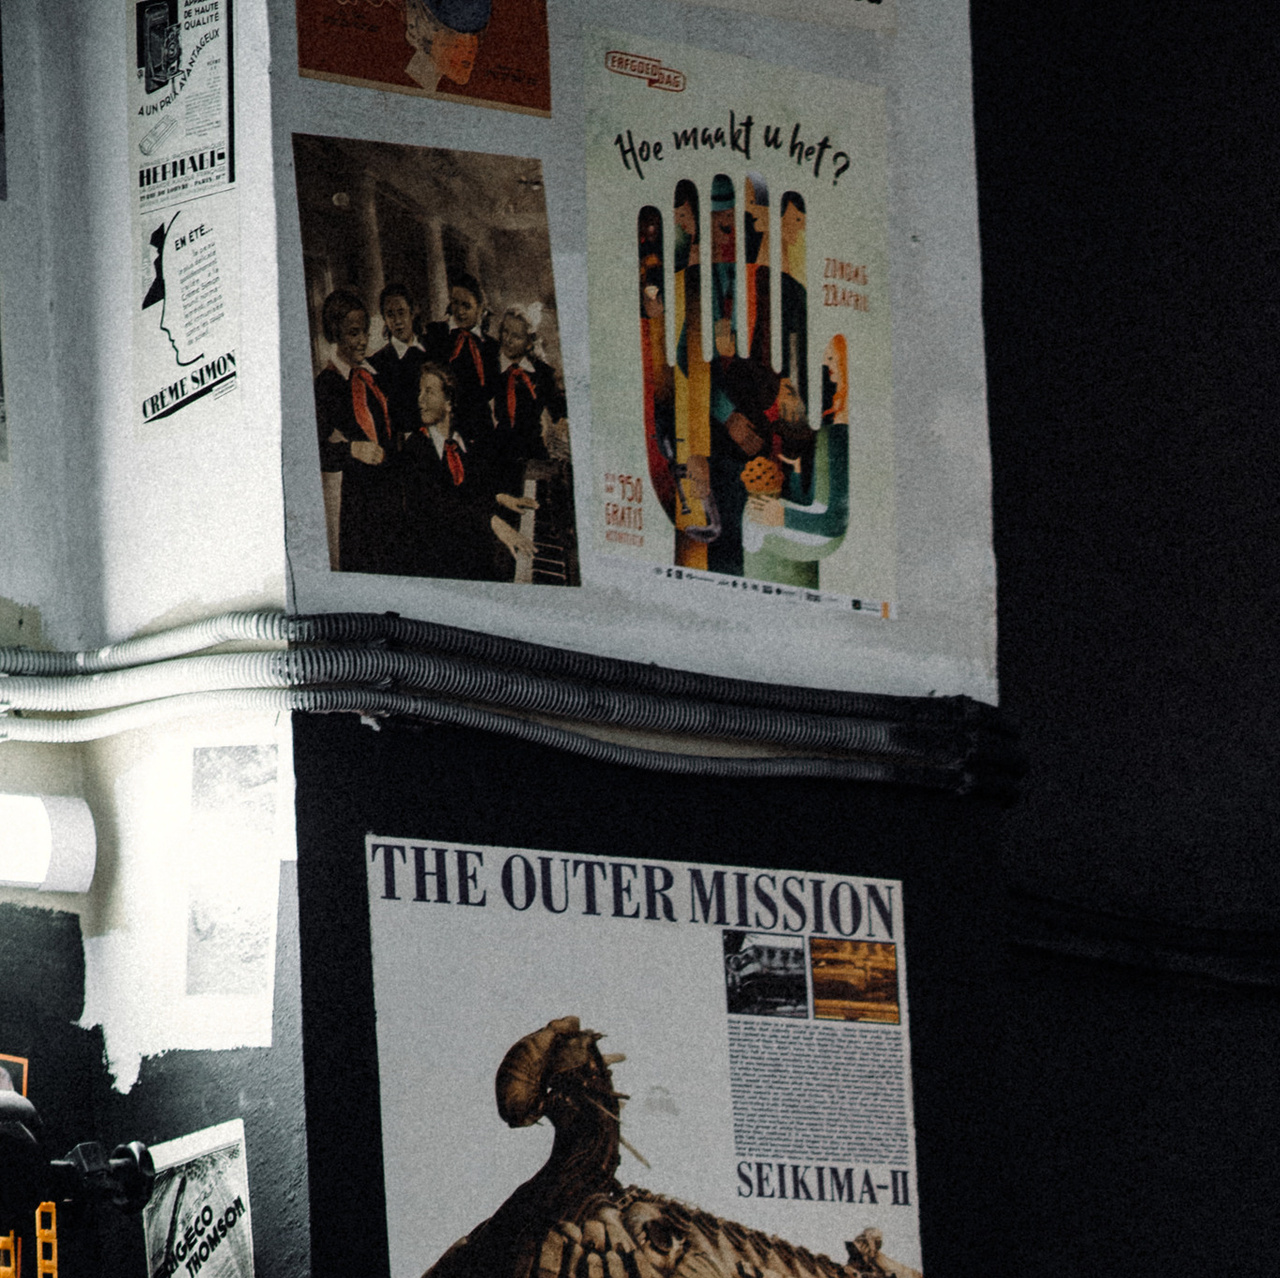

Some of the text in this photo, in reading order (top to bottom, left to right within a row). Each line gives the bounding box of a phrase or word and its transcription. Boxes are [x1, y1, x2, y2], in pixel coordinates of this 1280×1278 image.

[611, 55, 681, 89] ERFGOED DAG
[614, 130, 663, 180] Hoe
[673, 110, 755, 161] maakt
[764, 125, 784, 150] u
[142, 350, 237, 419] CRÈME SIMON
[371, 843, 896, 940] THE OUTER MISSION
